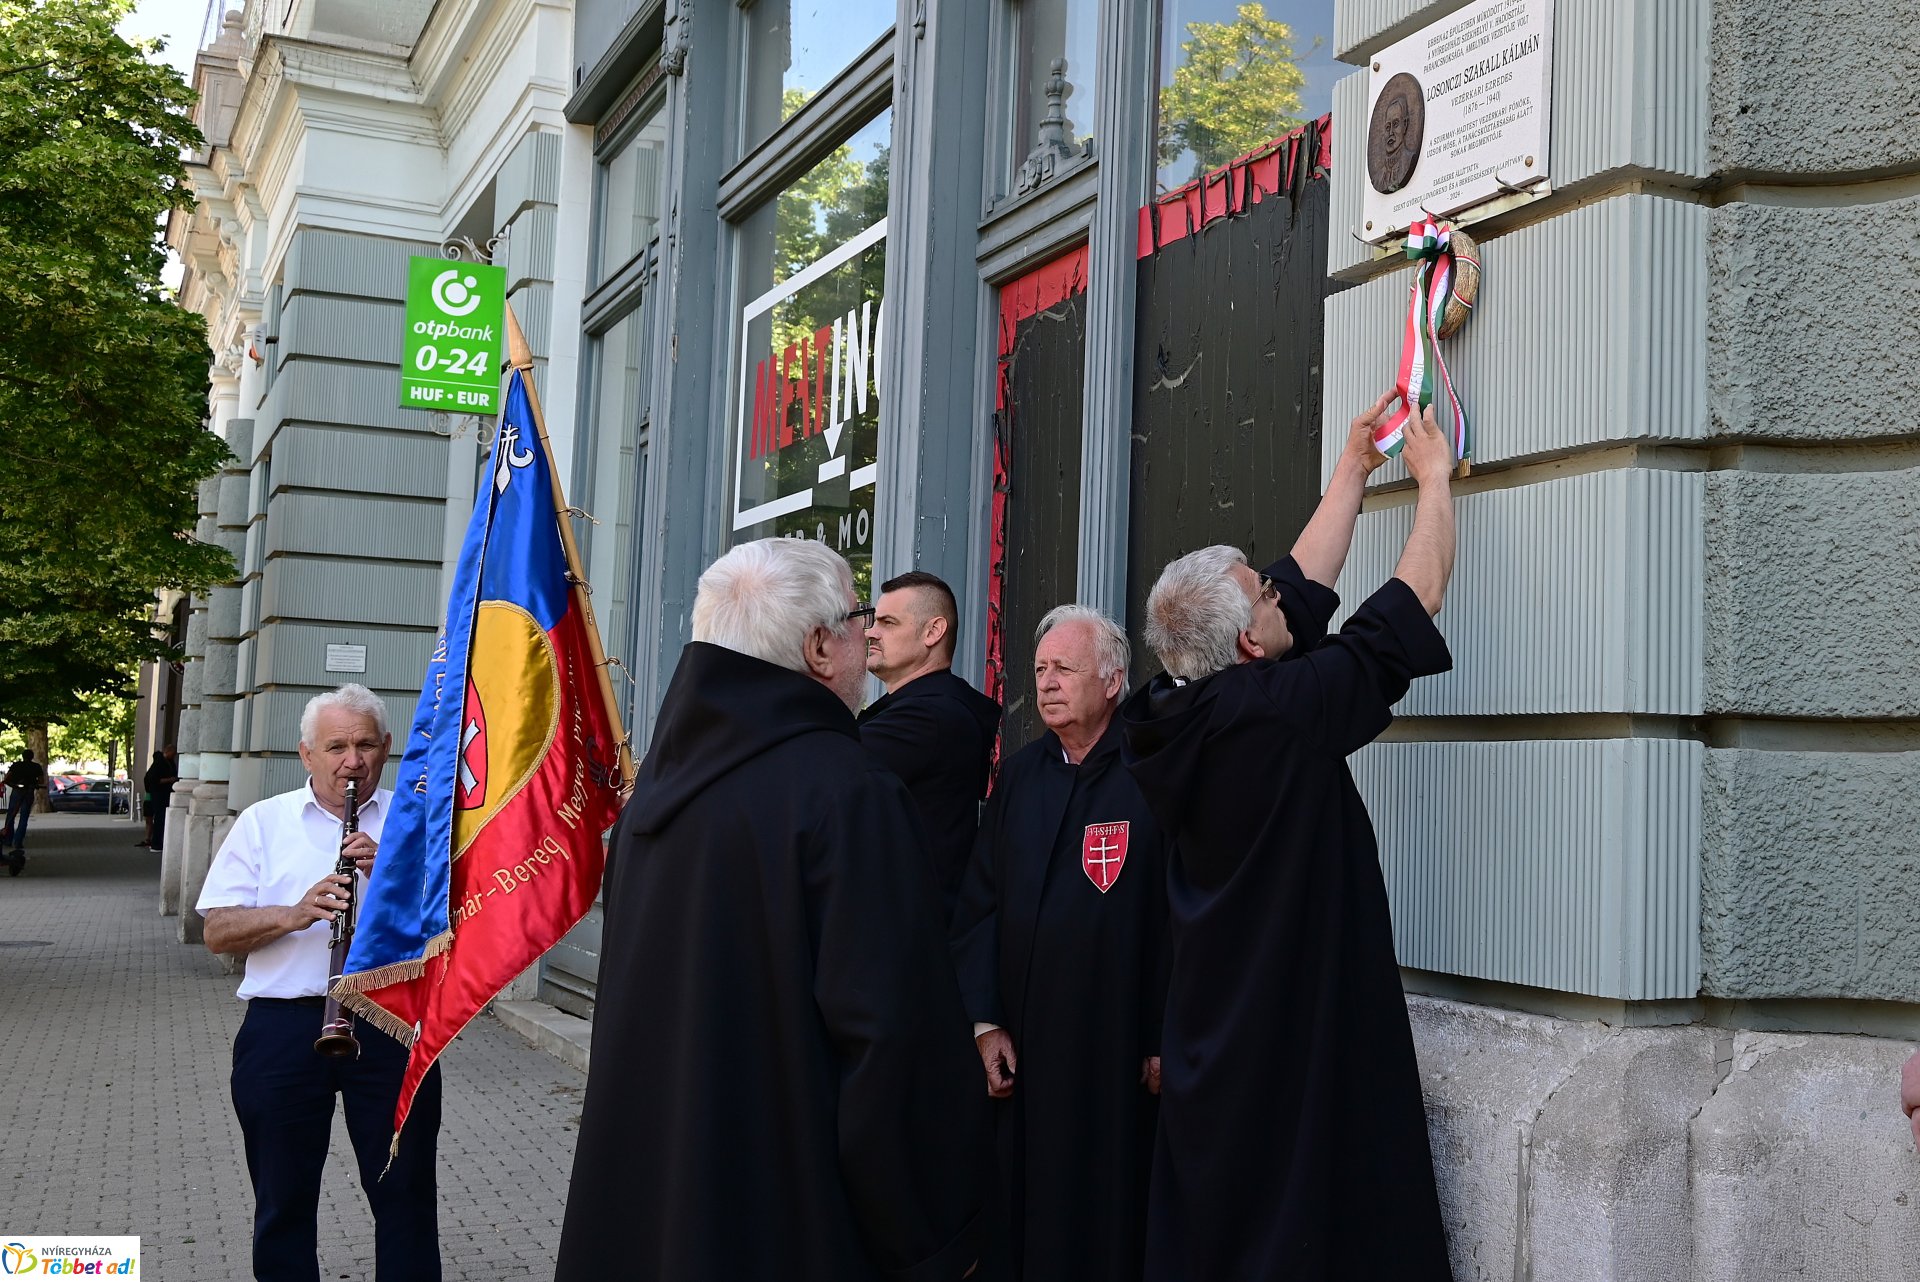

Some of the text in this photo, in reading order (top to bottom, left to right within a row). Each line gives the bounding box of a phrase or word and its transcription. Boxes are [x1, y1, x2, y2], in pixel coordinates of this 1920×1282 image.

[1427, 33, 1540, 102] LOSONCZI SZAKALL KÁLMÁN
[1451, 72, 1513, 108] VEZÉRKARI EZREDES
[1516, 105, 1534, 120] ALATT
[413, 320, 494, 342] otpbank
[415, 345, 489, 377] 0-24
[410, 386, 490, 407] HUF EUR
[557, 754, 589, 830] Megyei
